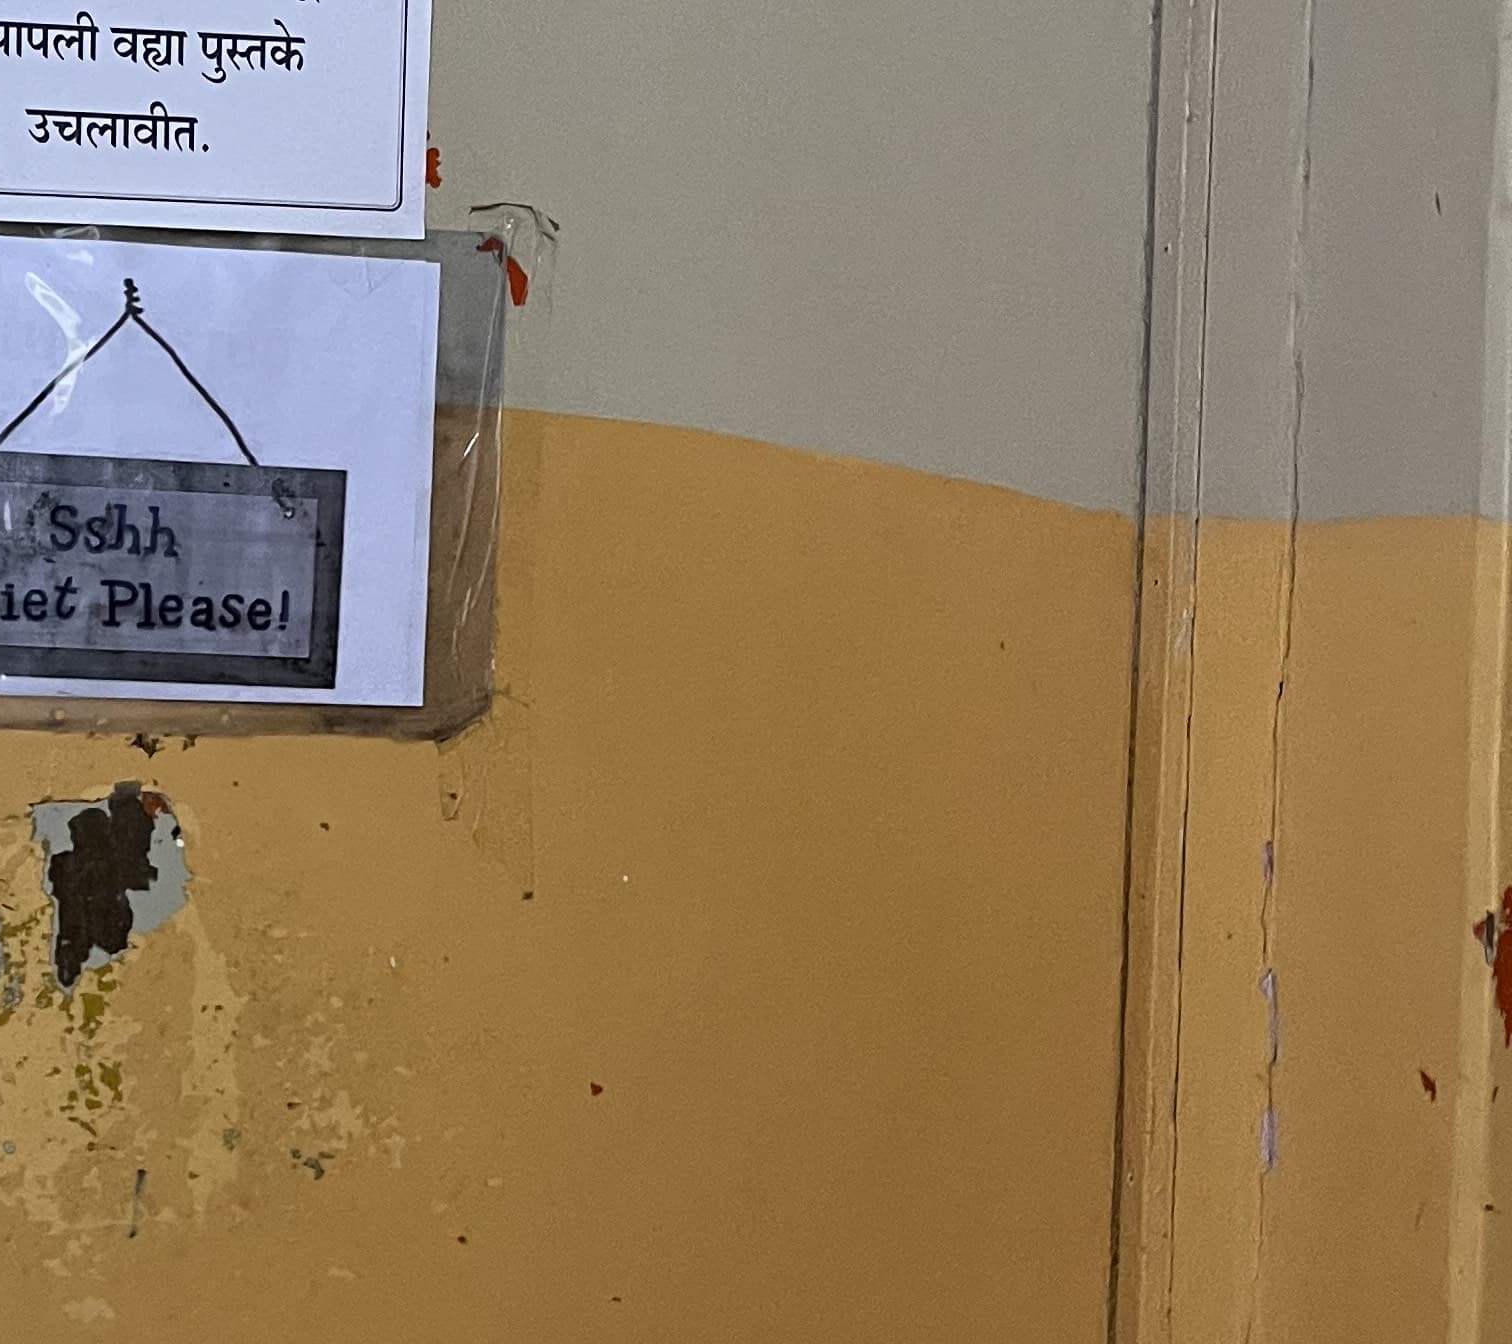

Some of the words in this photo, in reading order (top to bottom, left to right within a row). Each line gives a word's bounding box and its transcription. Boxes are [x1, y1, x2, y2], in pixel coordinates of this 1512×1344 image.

[109, 27, 188, 72] वह्या
[196, 18, 306, 84] पुस्तके
[24, 100, 210, 153] उचलावीत.
[46, 499, 181, 561] Sshh
[96, 579, 290, 632] Please!
